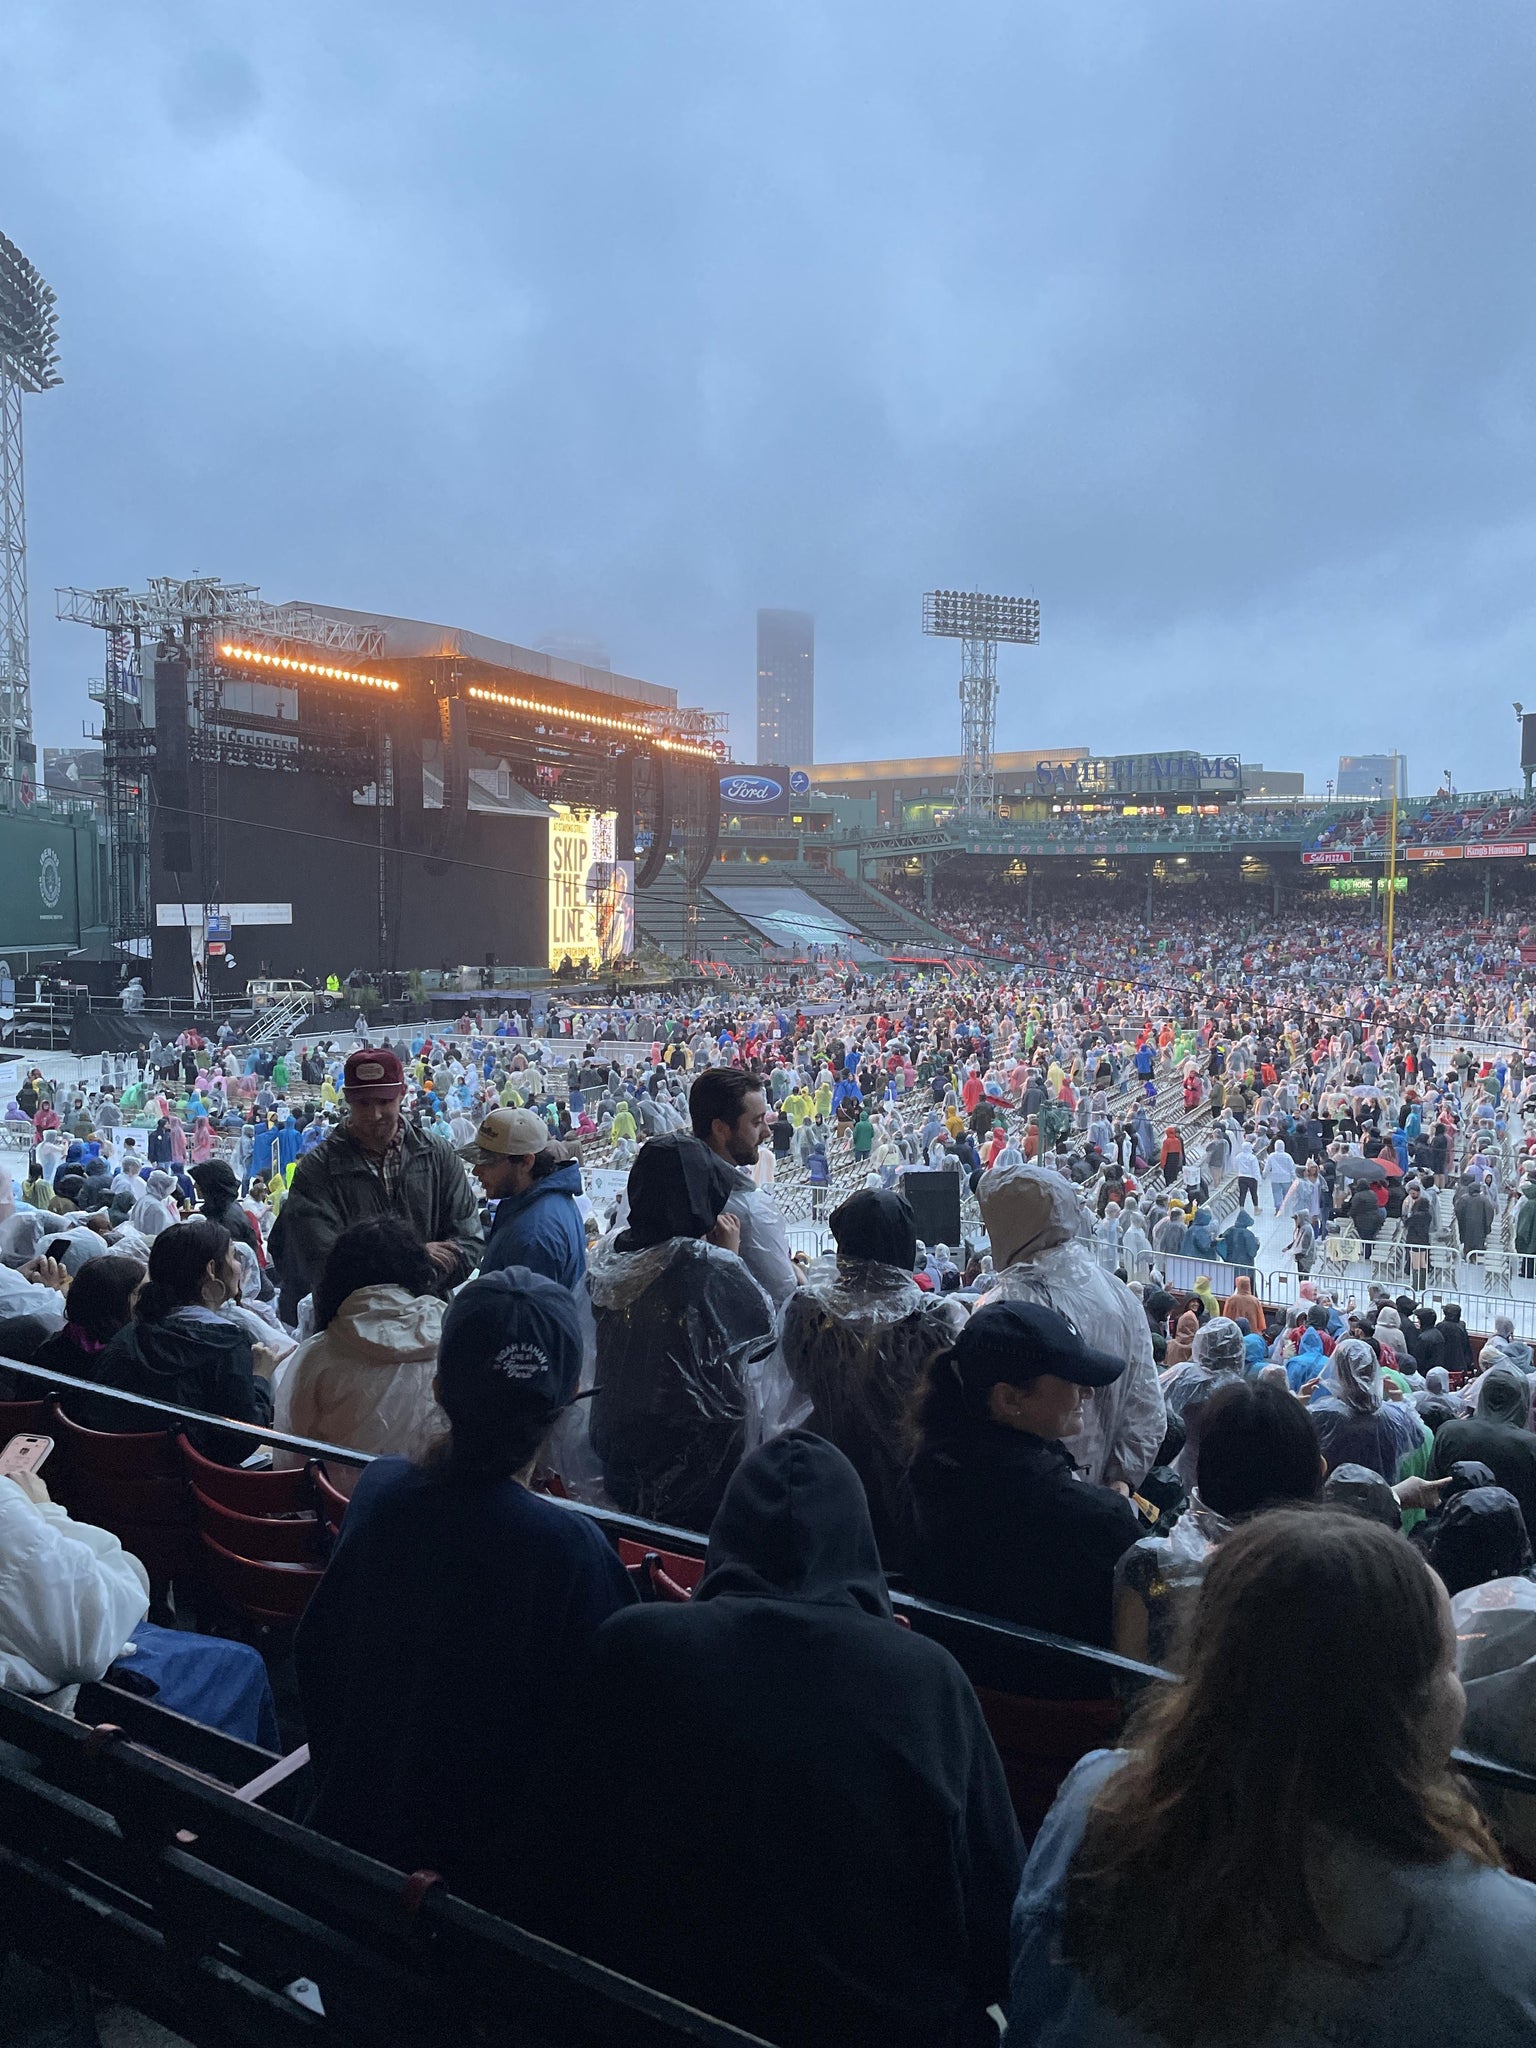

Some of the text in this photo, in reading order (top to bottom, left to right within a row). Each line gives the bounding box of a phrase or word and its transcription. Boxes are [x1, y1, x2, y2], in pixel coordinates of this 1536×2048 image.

[1148, 755, 1239, 781] ADAMS
[728, 778, 769, 799] Ford
[553, 836, 588, 872] SKIP
[1325, 854, 1345, 862] PIZZA
[1423, 849, 1446, 857] STIHL
[553, 873, 581, 907] THE
[553, 908, 585, 943] LINE
